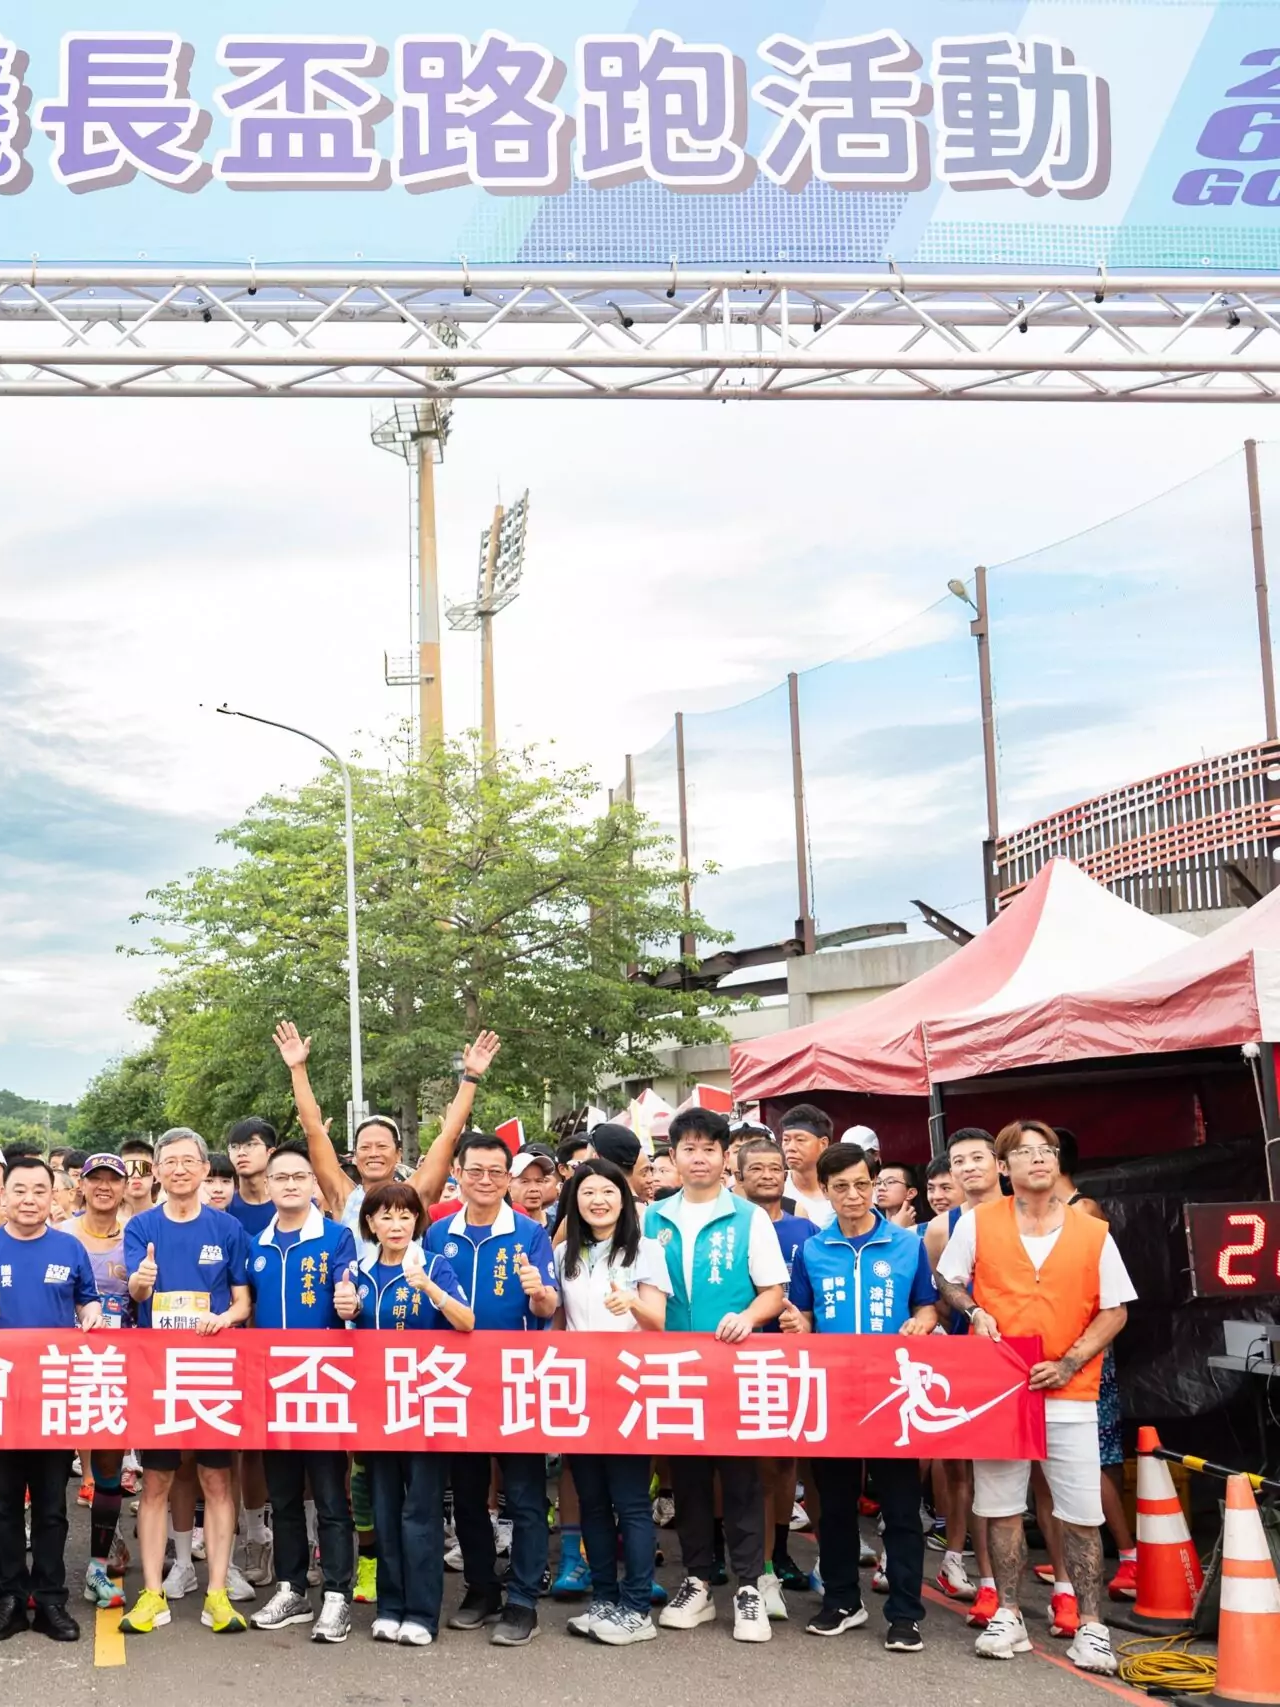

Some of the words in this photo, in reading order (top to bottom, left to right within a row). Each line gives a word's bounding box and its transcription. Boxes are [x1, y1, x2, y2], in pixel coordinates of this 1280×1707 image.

[1217, 1213, 1280, 1286] 2
[0, 1264, 12, 1288] 議長
[319, 1250, 330, 1286] 市議員
[411, 1286, 422, 1317] 議員
